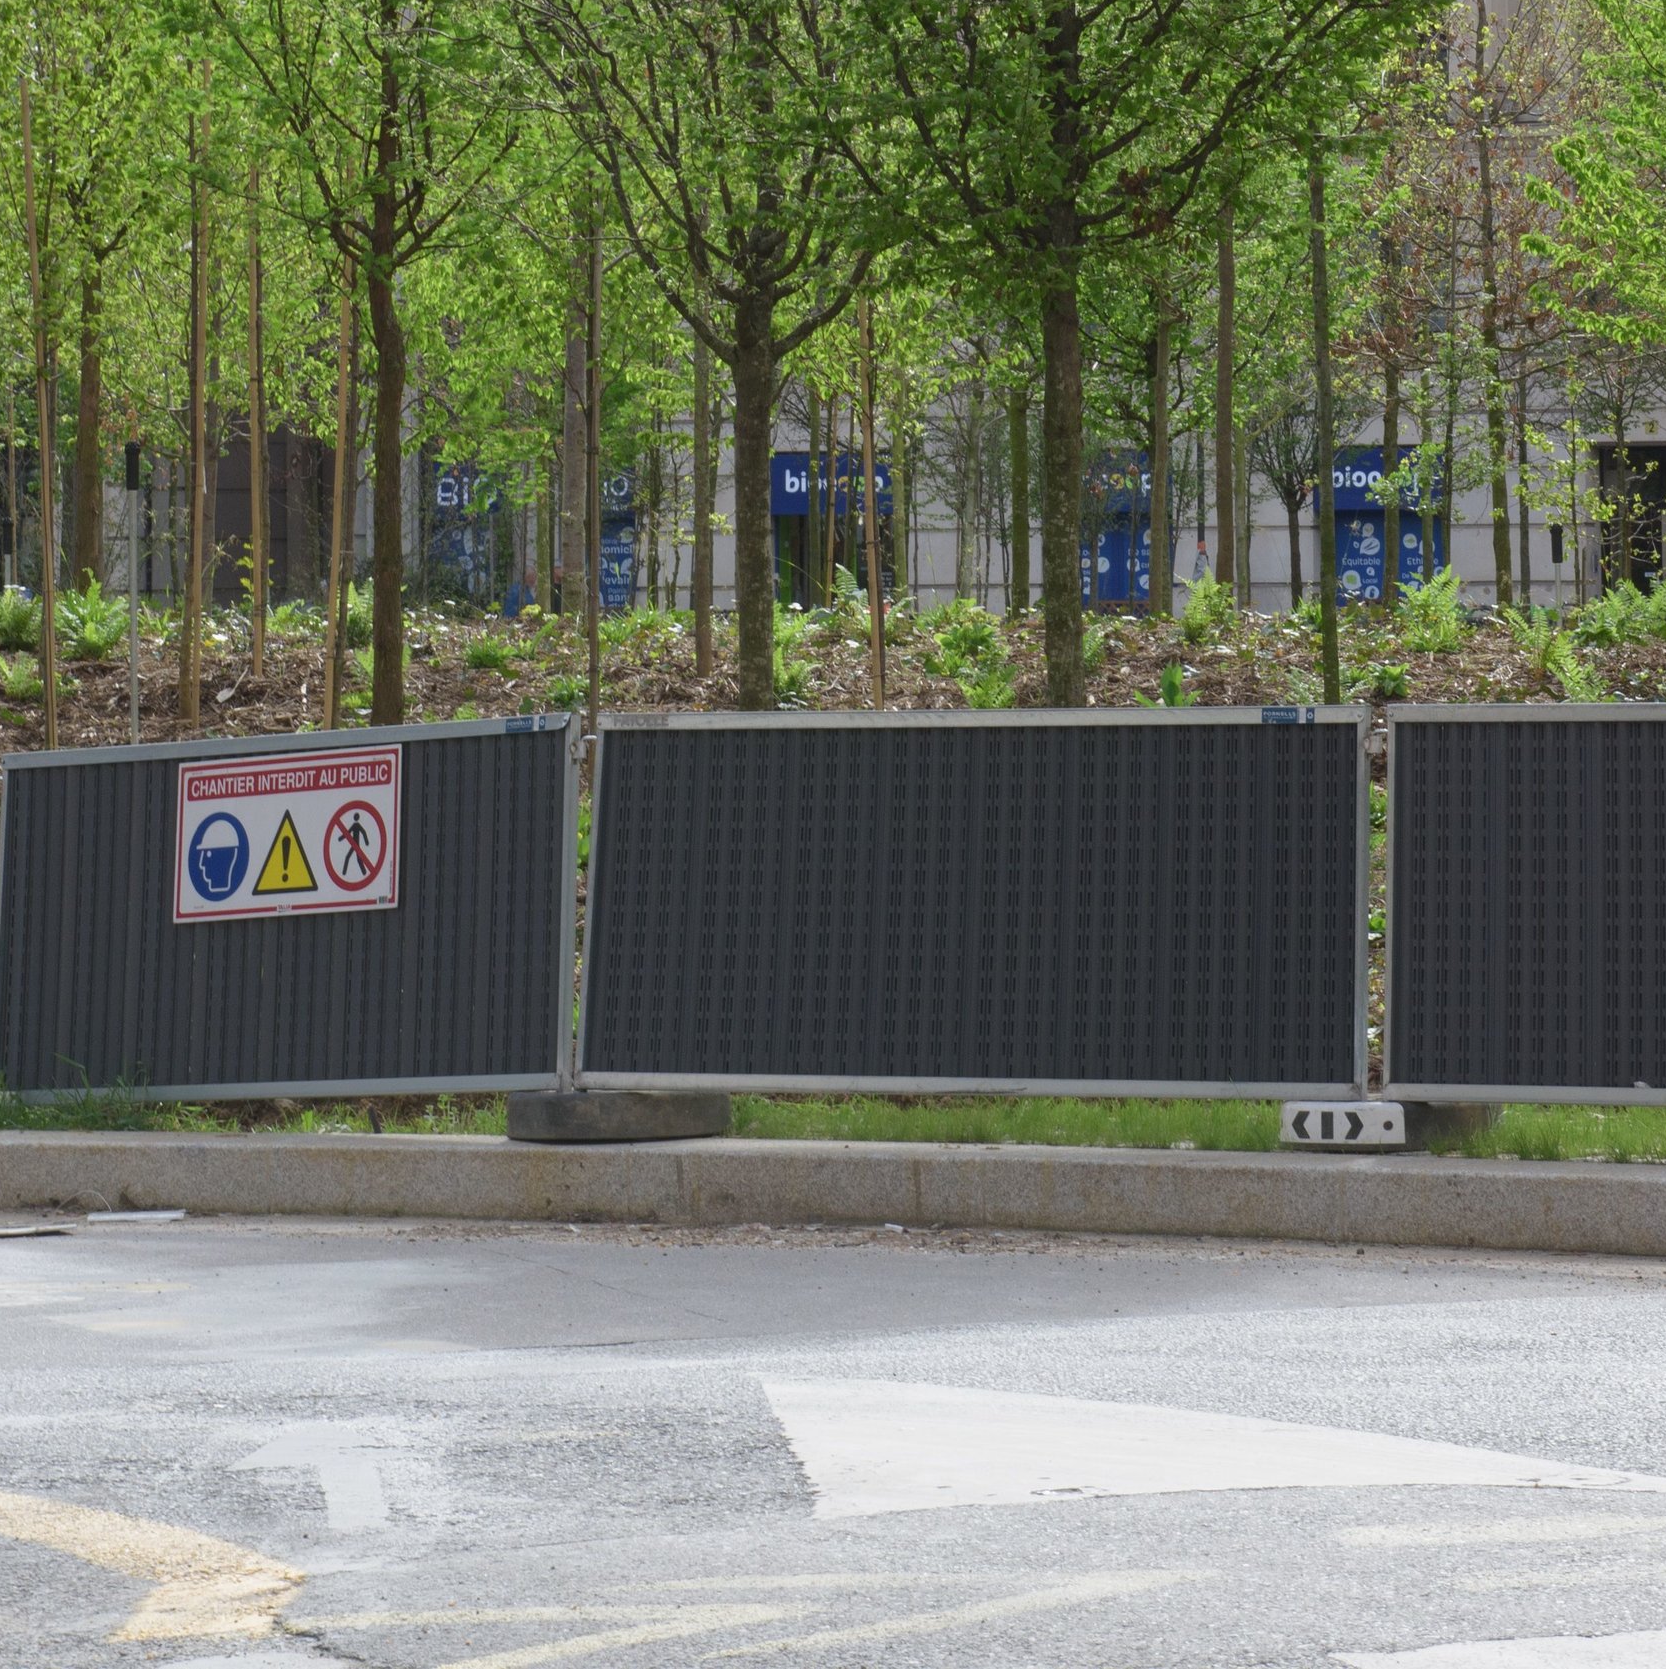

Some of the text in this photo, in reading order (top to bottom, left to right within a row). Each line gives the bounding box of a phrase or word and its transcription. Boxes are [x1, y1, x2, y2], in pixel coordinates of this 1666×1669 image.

[191, 763, 389, 798] CHANTIER INTERDIT AU PUBLIC
